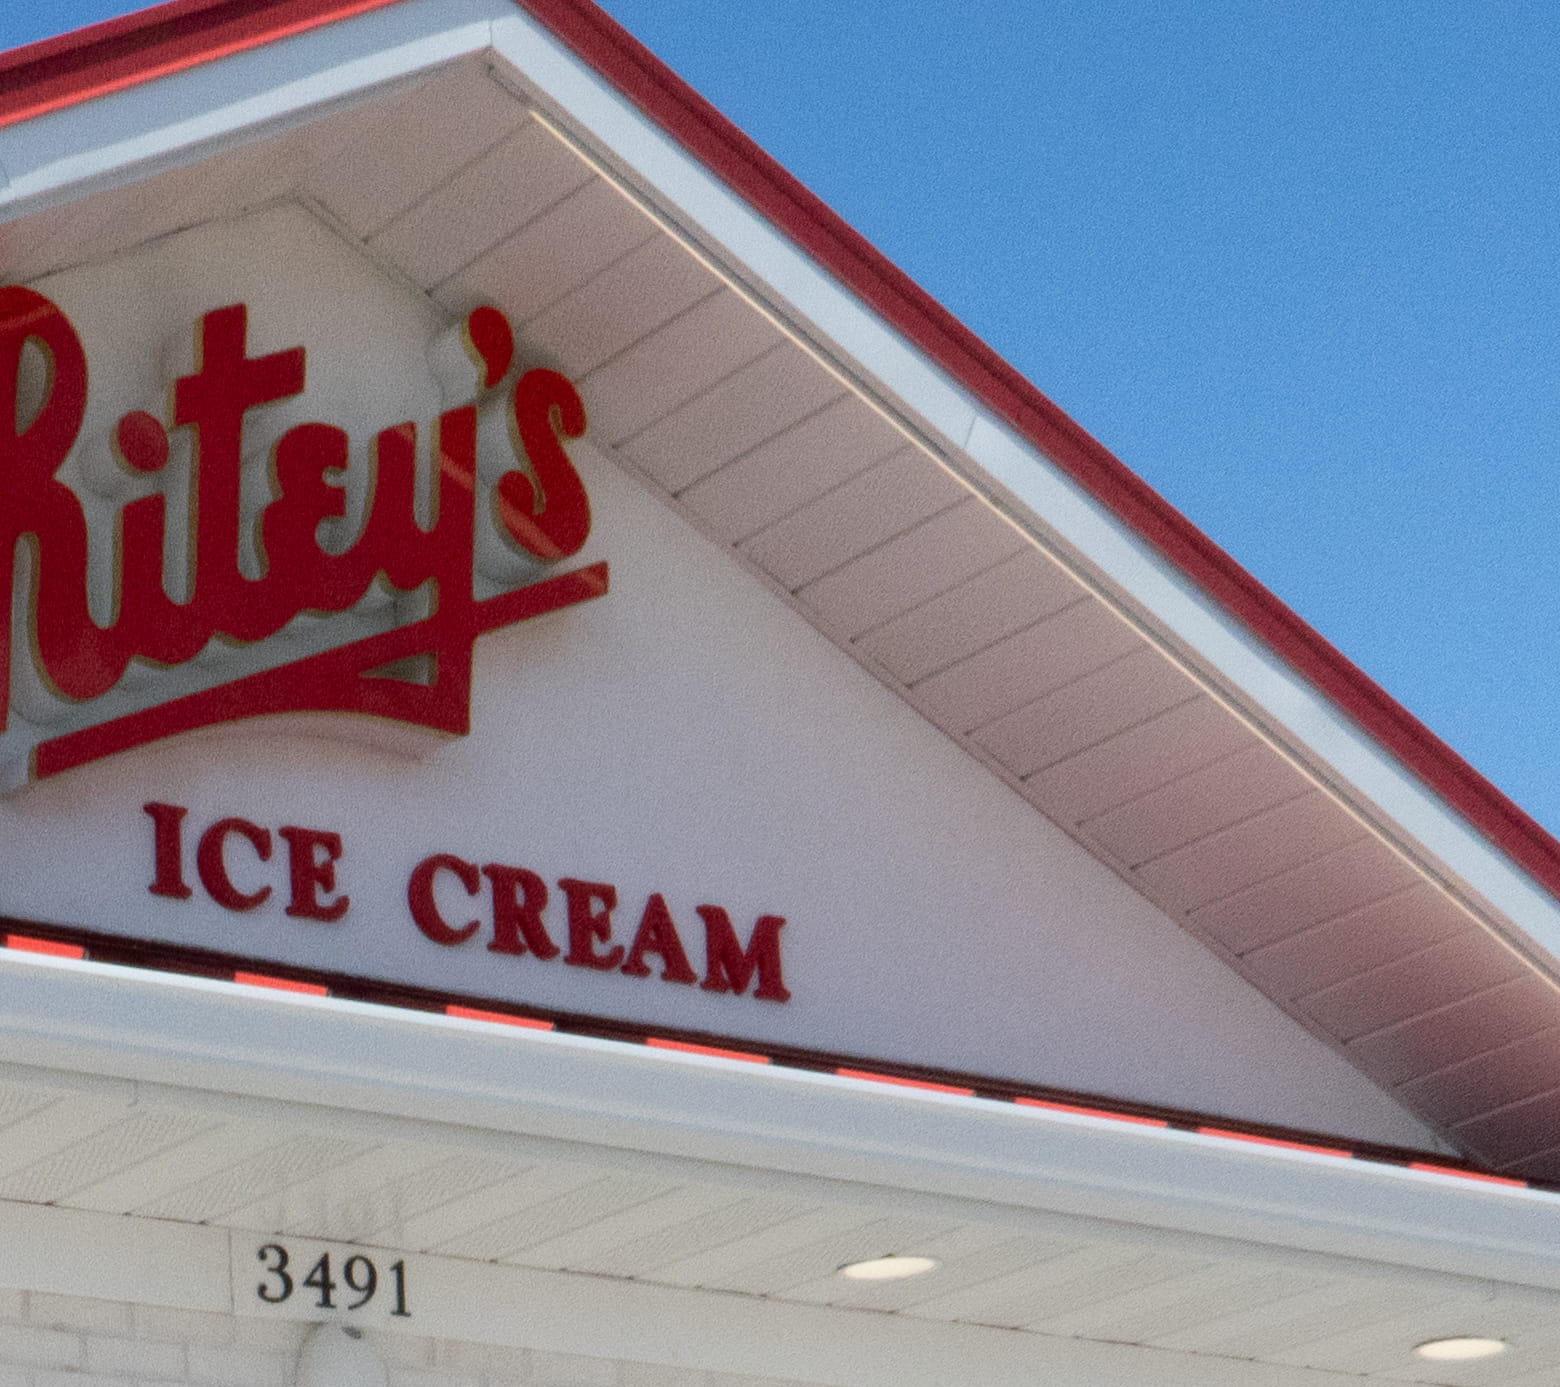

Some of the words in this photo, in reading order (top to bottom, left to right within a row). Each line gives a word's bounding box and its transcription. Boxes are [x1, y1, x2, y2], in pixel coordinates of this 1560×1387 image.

[144, 801, 350, 922] ICE
[407, 854, 791, 1002] CREAM
[257, 1244, 411, 1317] 3491
